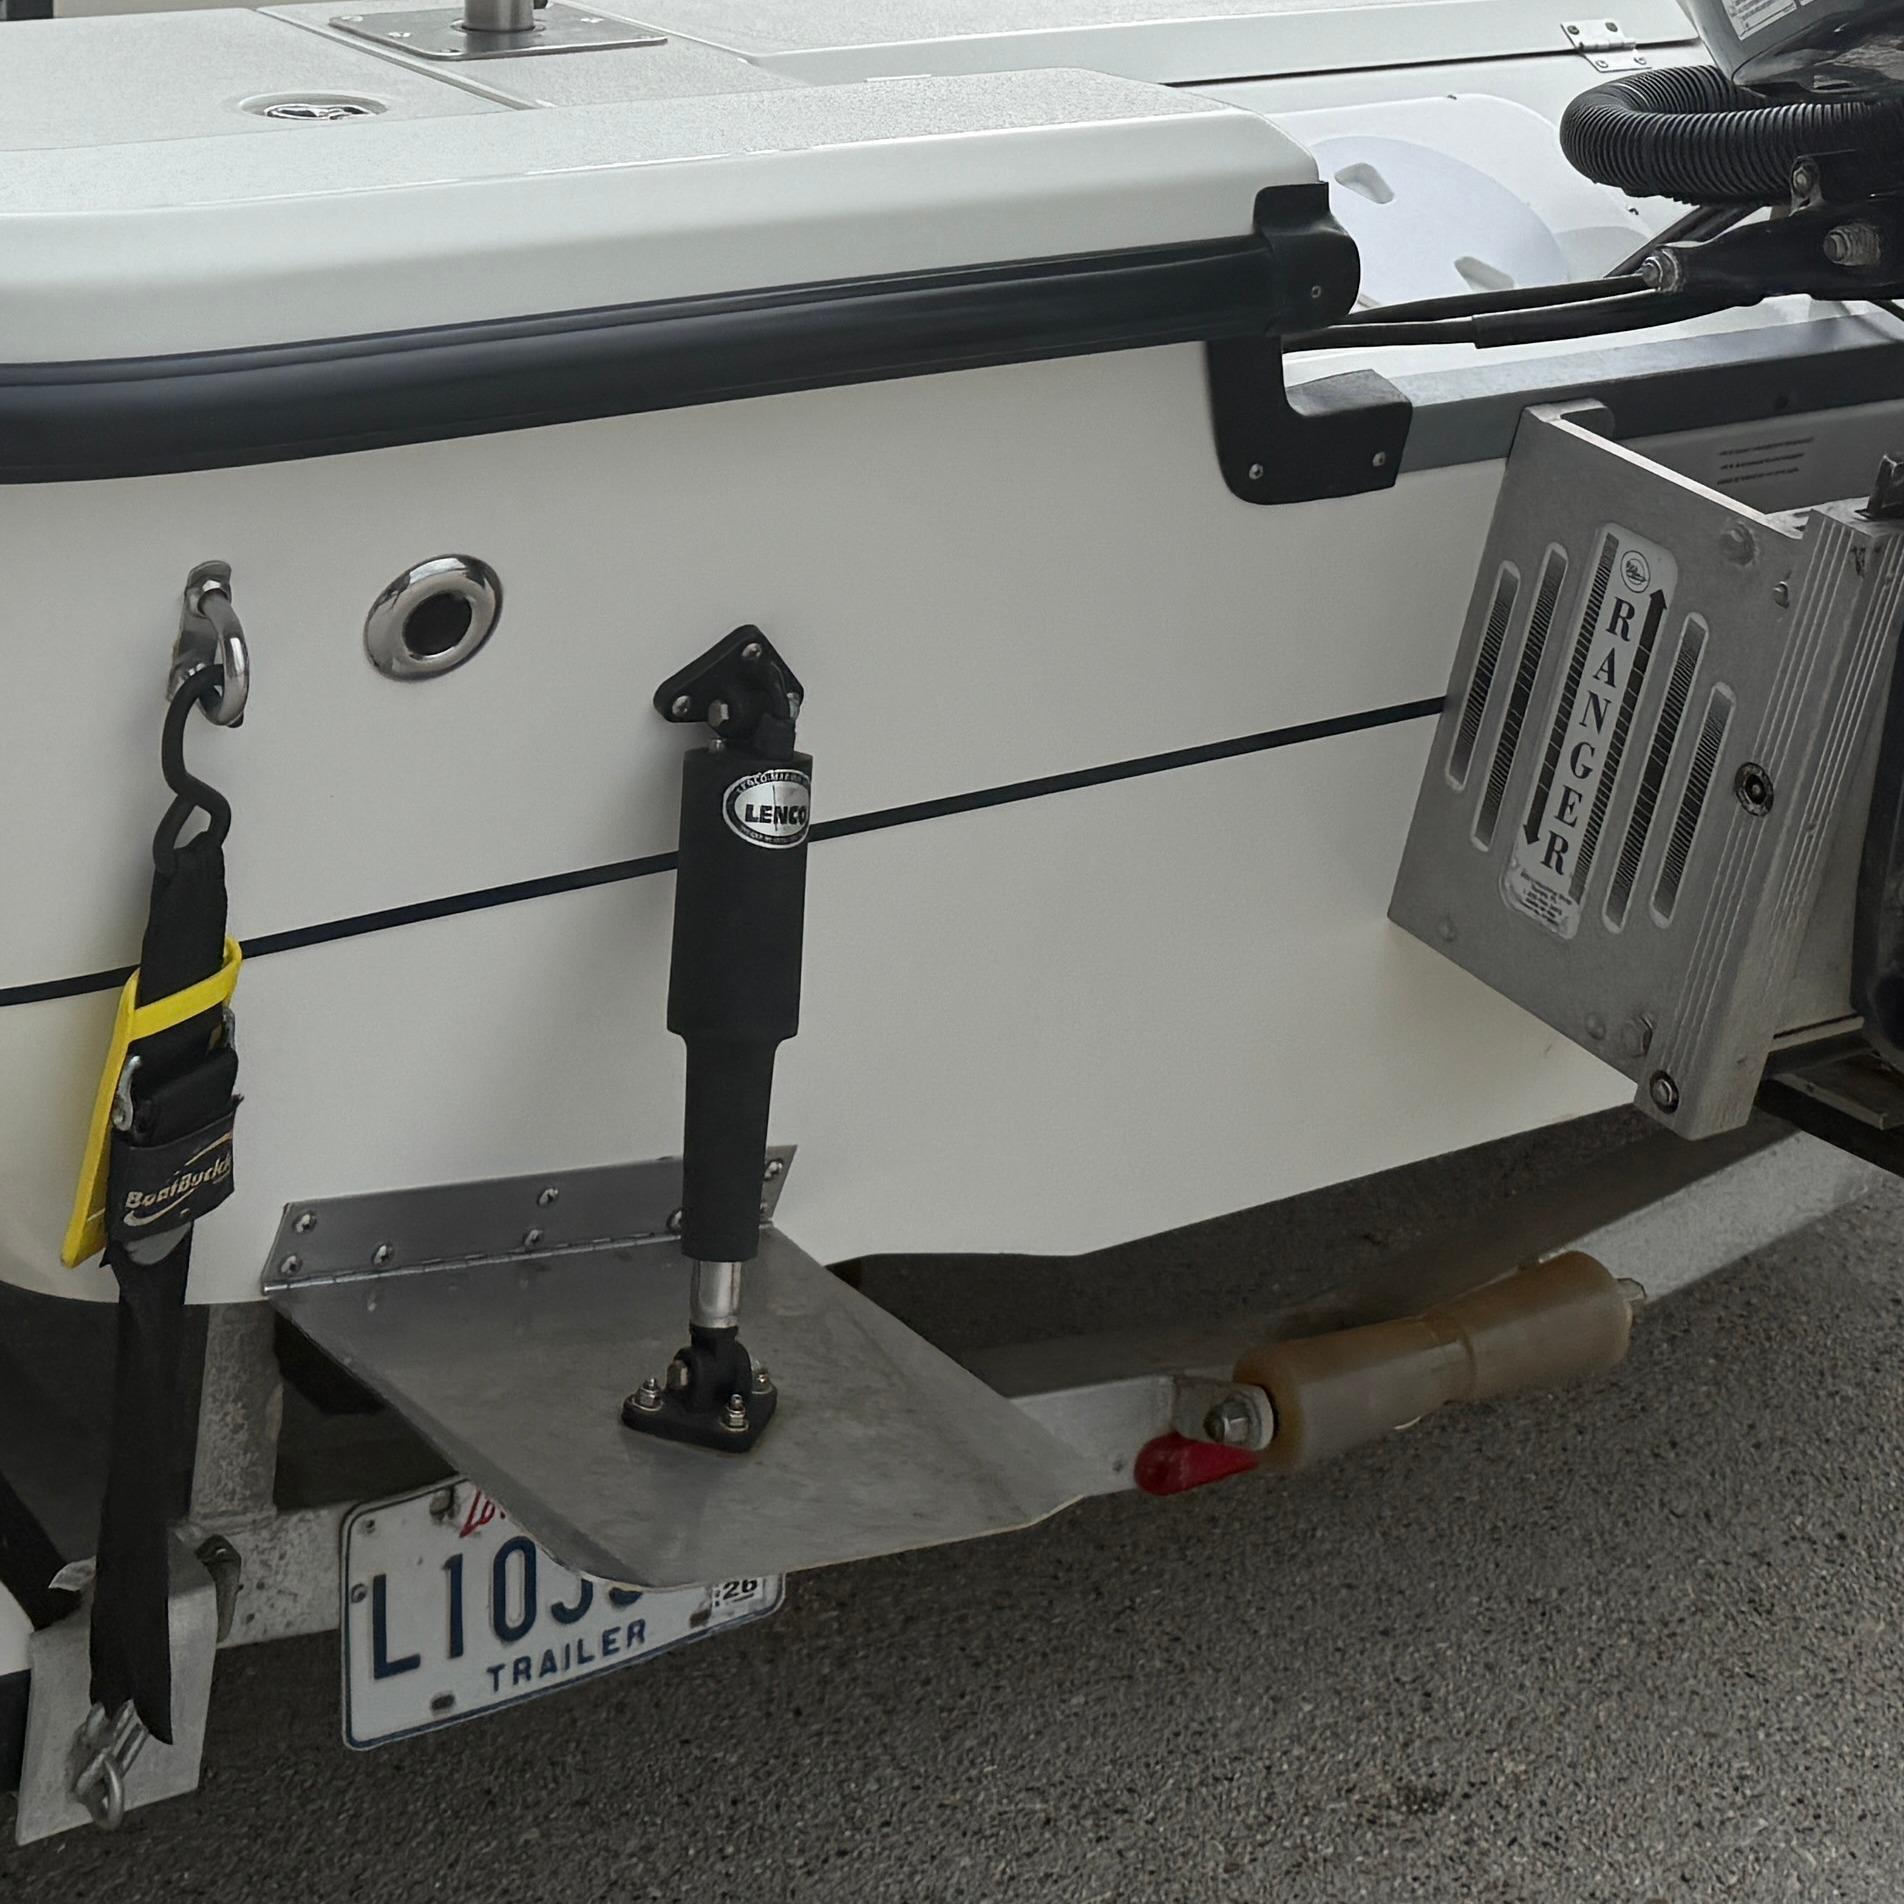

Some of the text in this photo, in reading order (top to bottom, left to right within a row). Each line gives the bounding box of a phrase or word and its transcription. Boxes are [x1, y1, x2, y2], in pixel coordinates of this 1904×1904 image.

[1539, 596, 1637, 877] RANGER
[744, 803, 807, 826] LENCO
[487, 1618, 648, 1693] TRAILER
